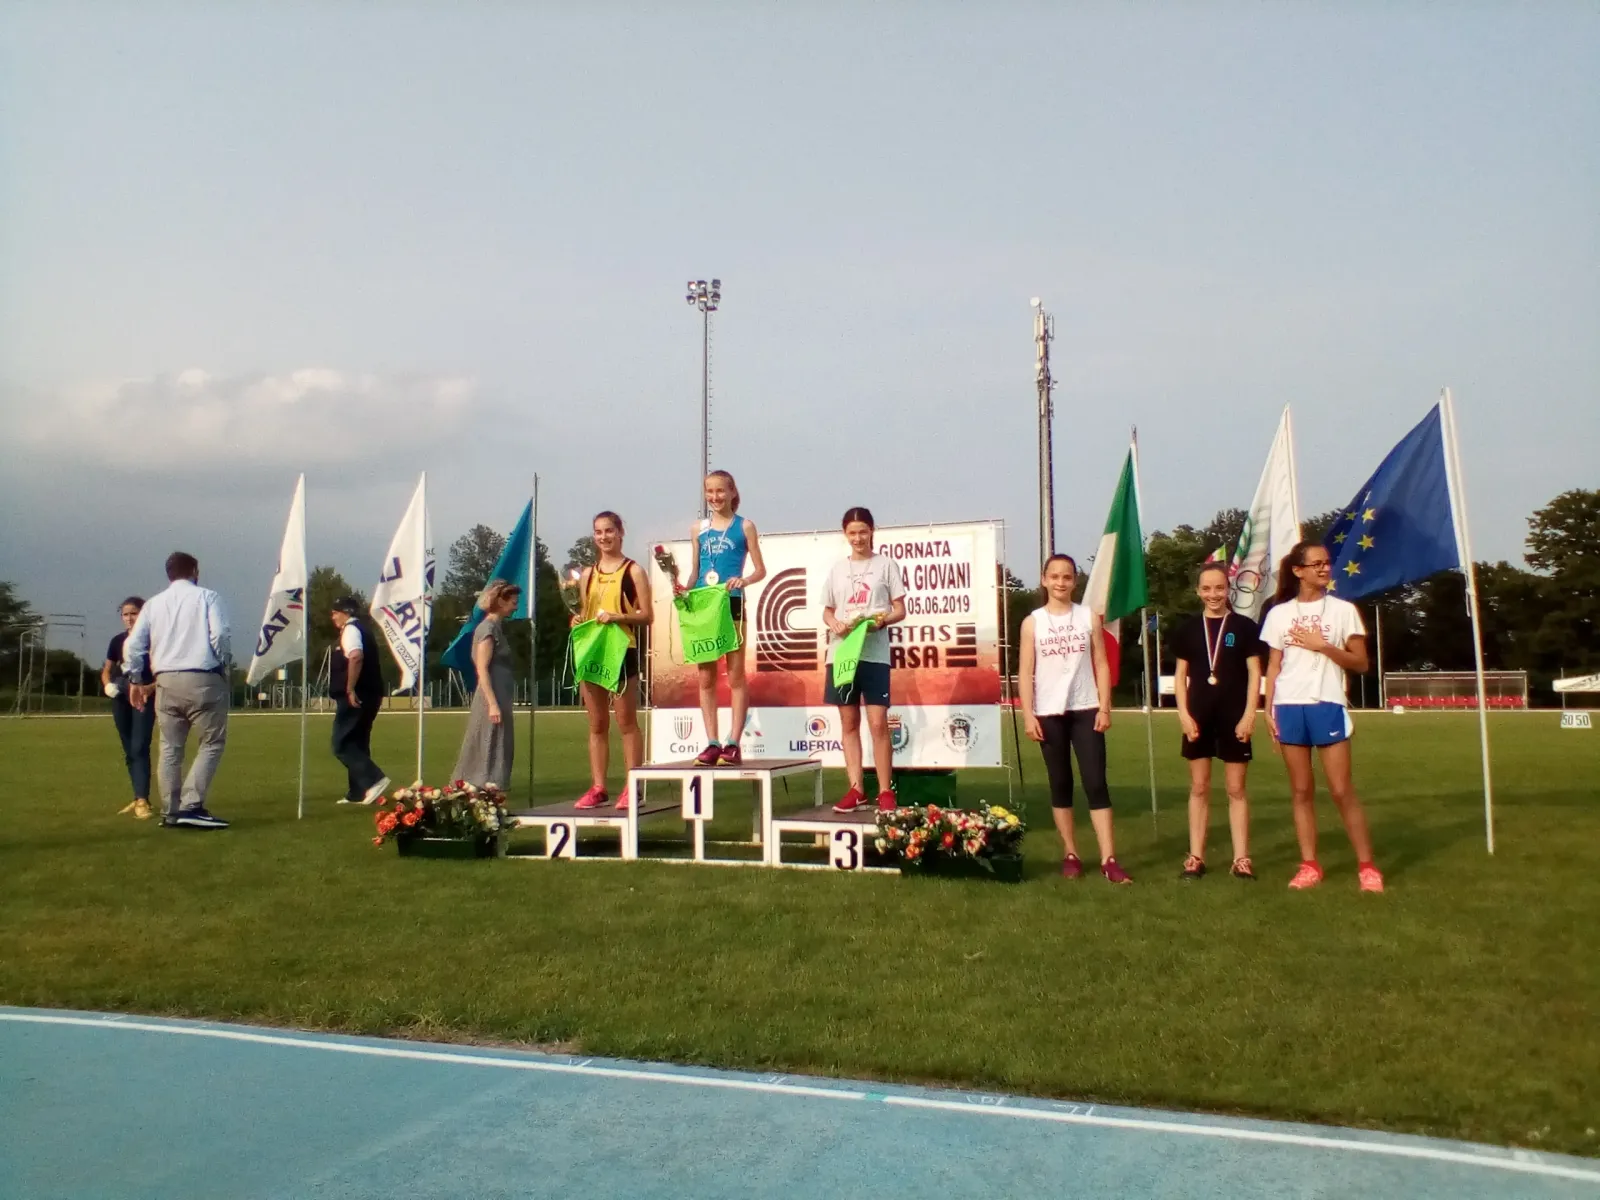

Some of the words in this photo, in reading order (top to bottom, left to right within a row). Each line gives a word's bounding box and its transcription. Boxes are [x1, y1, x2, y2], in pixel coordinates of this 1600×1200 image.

[879, 540, 952, 560] GIORNATA
[914, 562, 971, 591] GIOVANI
[908, 595, 970, 615] 05.06.2019
[888, 624, 952, 643] RTAS
[1041, 644, 1086, 657] SACILE
[1575, 714, 1589, 726] 50
[669, 742, 699, 754] Coni
[789, 740, 844, 752] LIBERTA
[689, 775, 701, 815] 1
[550, 823, 570, 859] 2
[834, 829, 858, 871] 3
